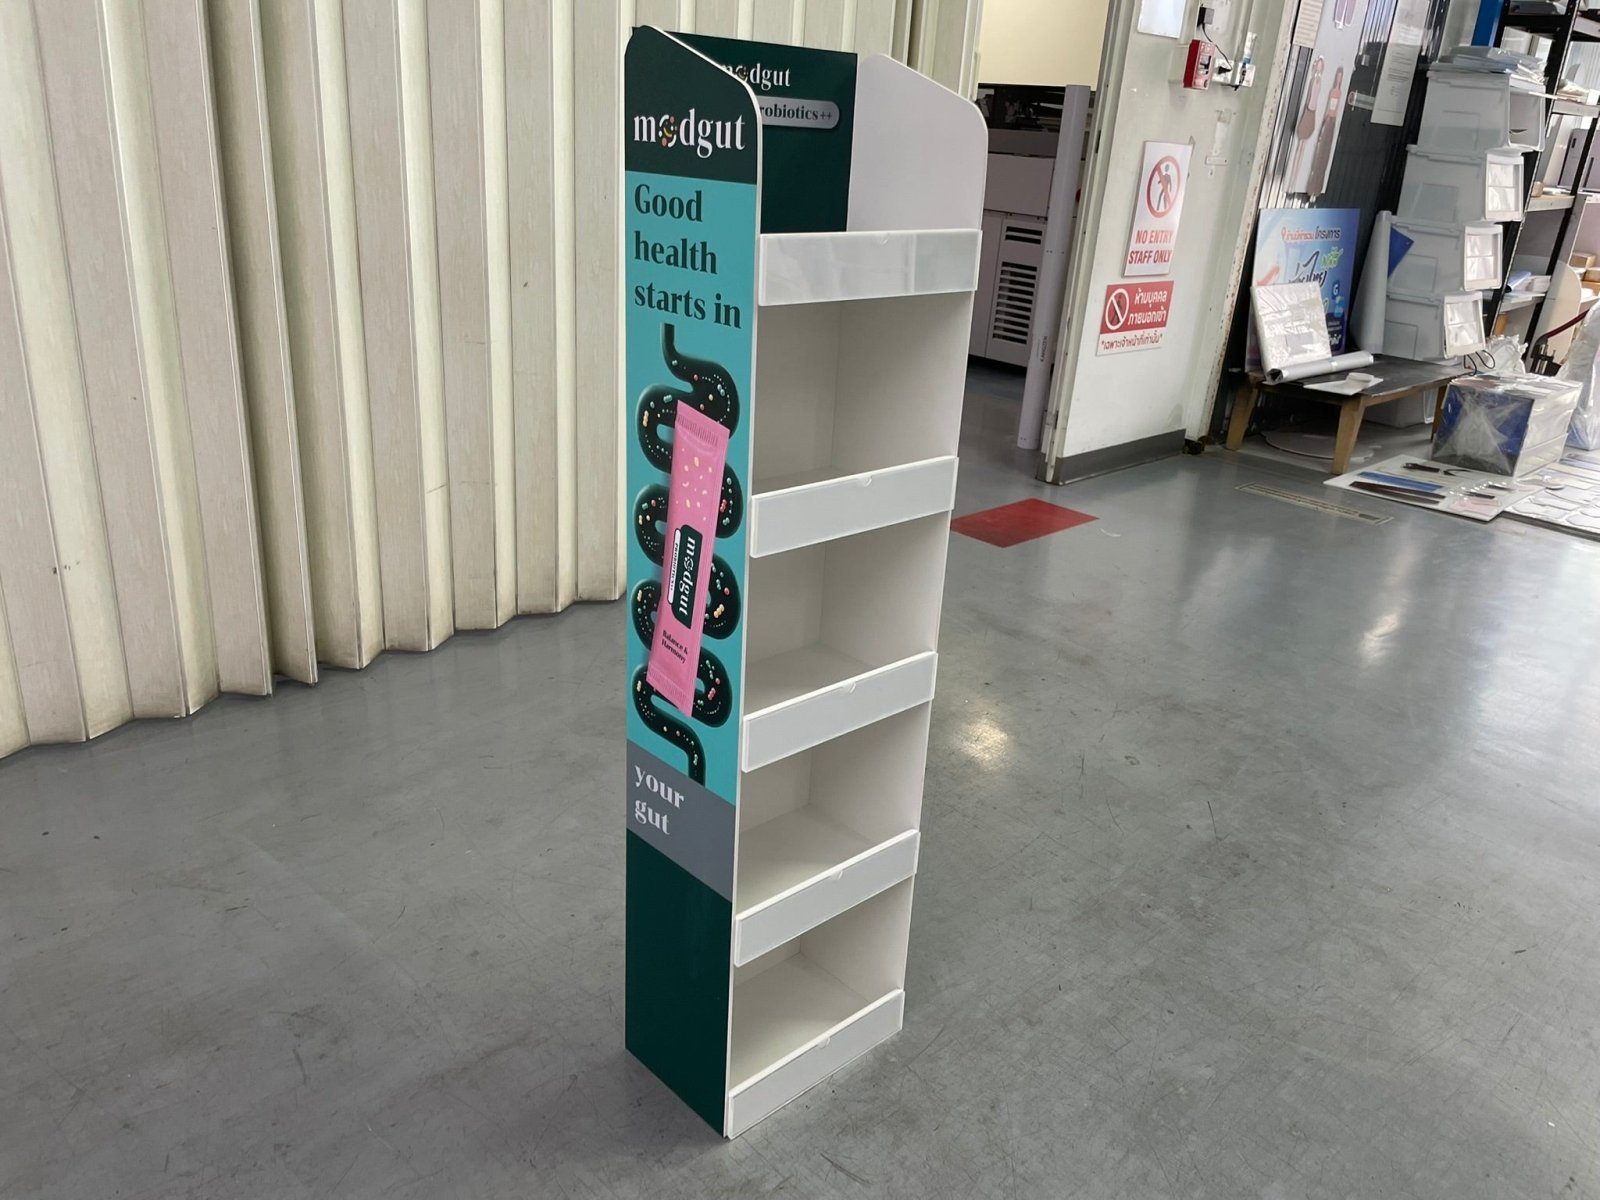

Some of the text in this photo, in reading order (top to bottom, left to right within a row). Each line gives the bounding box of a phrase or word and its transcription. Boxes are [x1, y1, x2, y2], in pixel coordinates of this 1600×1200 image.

[760, 104, 832, 120] robiotics++
[633, 107, 746, 159] modgut
[634, 183, 703, 222] Good
[1135, 229, 1174, 244] NO ENTRY
[634, 230, 718, 275] health
[1128, 249, 1173, 264] STAFF ONLY
[634, 281, 742, 330] starts in
[1134, 287, 1168, 309] ห้ามบุคคล
[1127, 305, 1167, 326] ภายนอกเข้า
[679, 536, 696, 616] modgut
[661, 638, 686, 664] Harmony
[662, 629, 684, 650] Balance
[634, 765, 684, 809] your
[635, 799, 670, 835] gut
